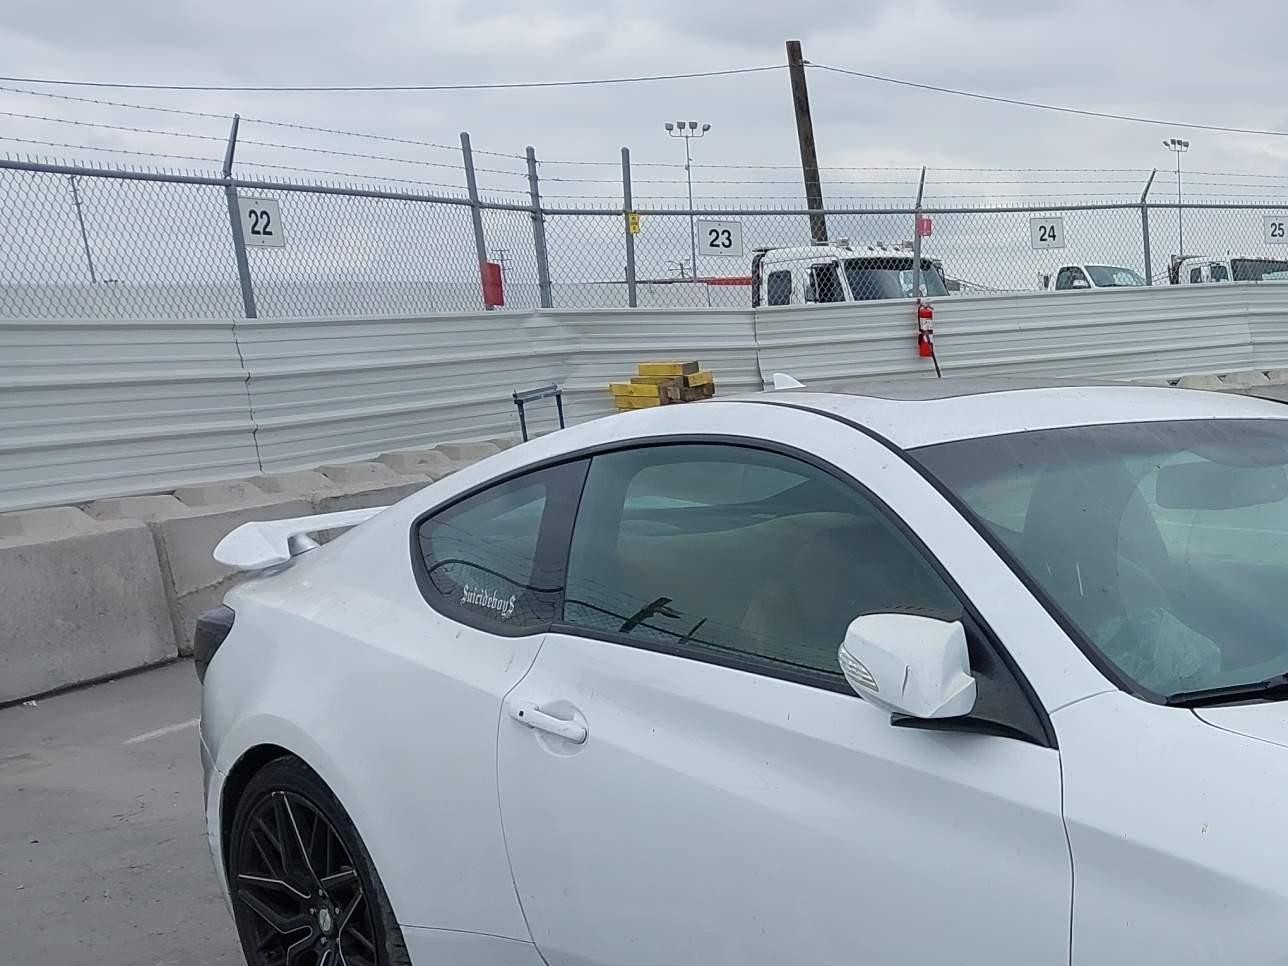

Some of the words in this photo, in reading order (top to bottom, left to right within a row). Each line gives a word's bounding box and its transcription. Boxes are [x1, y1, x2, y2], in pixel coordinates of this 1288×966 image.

[248, 209, 273, 236] 22
[1270, 222, 1285, 238] 25
[708, 228, 733, 249] 23
[1038, 225, 1057, 242] 24
